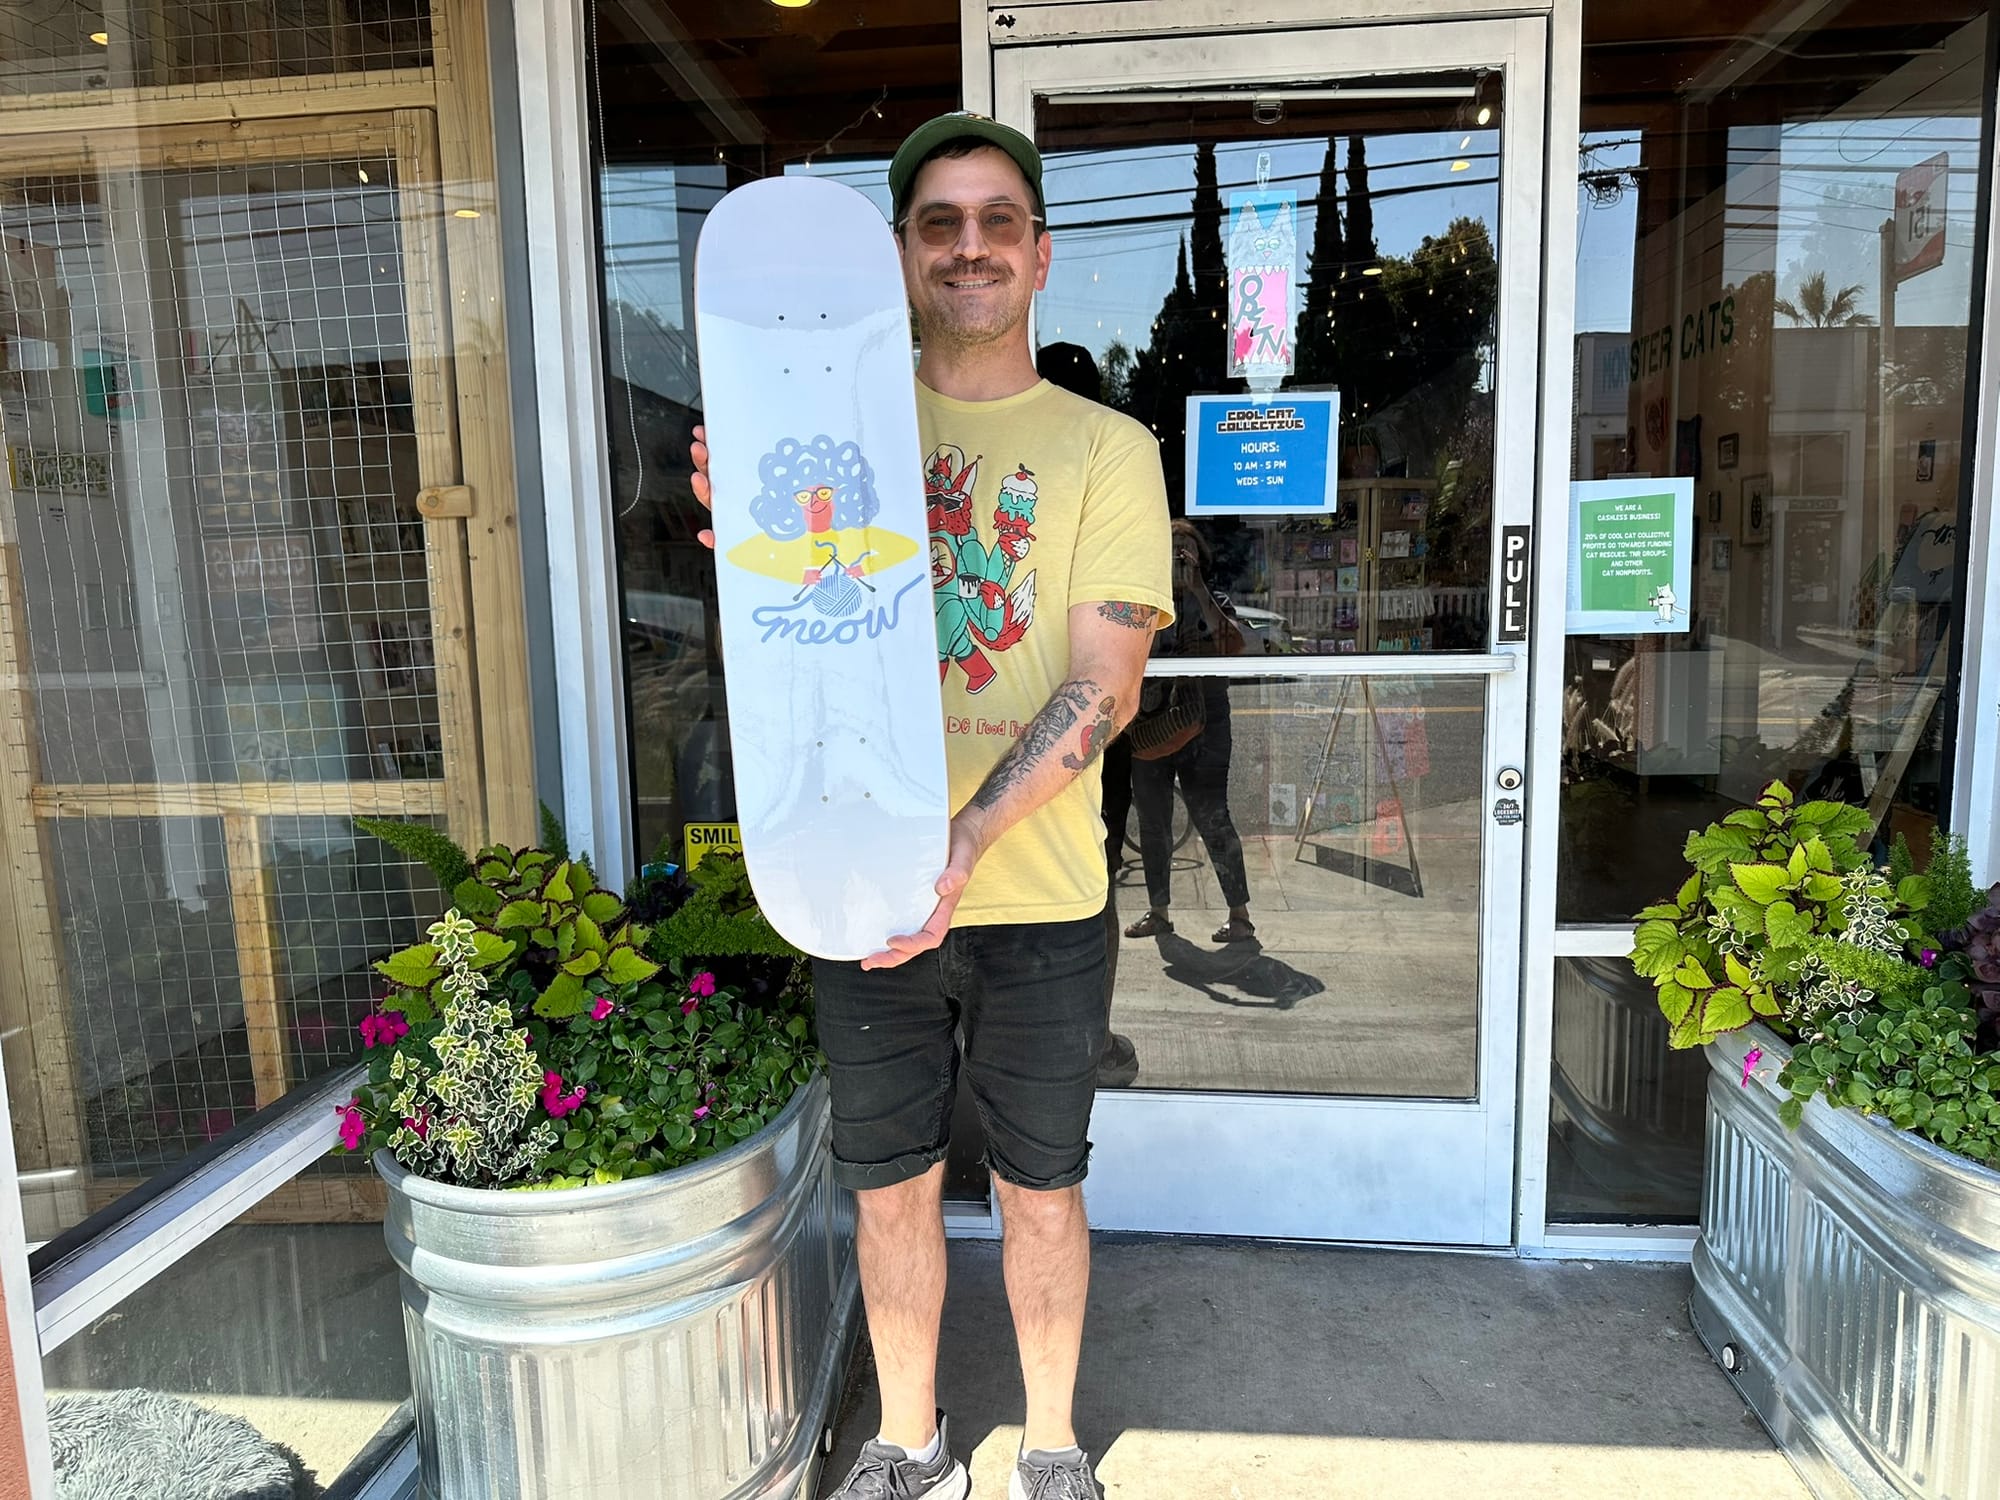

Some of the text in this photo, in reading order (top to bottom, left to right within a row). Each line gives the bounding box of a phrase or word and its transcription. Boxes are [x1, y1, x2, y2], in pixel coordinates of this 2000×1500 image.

[1680, 295, 1736, 361] CATS
[1227, 408, 1295, 421] COOL CAT
[1217, 419, 1304, 433] COLLECTIVE
[1240, 441, 1280, 454] HOURS:
[1233, 461, 1243, 471] 10
[1244, 461, 1258, 470] AM
[1265, 460, 1272, 470] 5
[1273, 460, 1287, 469] PM
[1235, 476, 1259, 486] WEDS
[1266, 475, 1284, 485] SUN
[1614, 504, 1623, 512] WE
[1597, 513, 1628, 521] CASHLESS
[1608, 532, 1623, 540] COOL
[1637, 531, 1671, 539] COLLECTIVE
[1617, 541, 1646, 549] TOWARDS
[1647, 540, 1672, 548] FUNDING
[1585, 551, 1598, 559] CAT
[1610, 559, 1643, 567] AND OTHER
[1601, 569, 1614, 577] CAT
[1505, 535, 1525, 632] PULL
[947, 715, 971, 735] DC
[976, 717, 1006, 736] Food
[690, 827, 738, 844] SMIL
